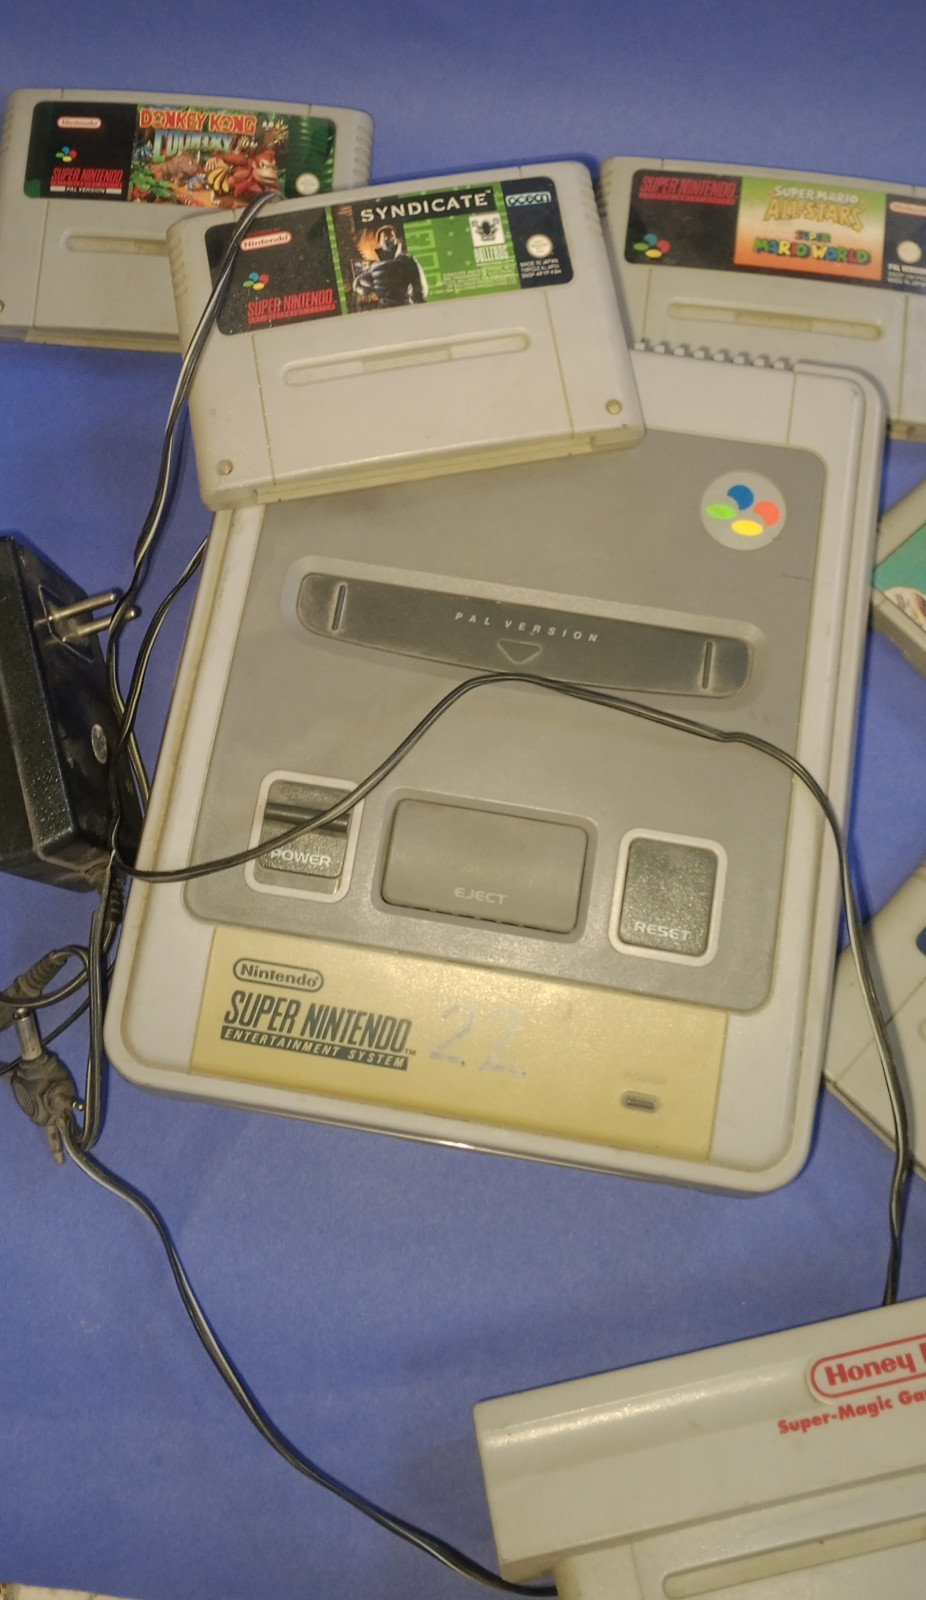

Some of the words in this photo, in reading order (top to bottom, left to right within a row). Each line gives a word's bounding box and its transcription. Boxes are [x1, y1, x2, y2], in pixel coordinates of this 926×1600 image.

[140, 108, 208, 131] DONKEY
[208, 112, 257, 136] KONG
[153, 129, 235, 163] COUNTRY
[52, 167, 81, 181] SUPER
[80, 168, 124, 184] NINTENDO
[641, 175, 678, 194] SUPER
[679, 178, 738, 198] NINTENDO
[360, 194, 488, 222] SYNDICATE
[775, 186, 815, 200] SUPER
[816, 190, 859, 205] MARIO
[795, 230, 831, 243] SUPER
[754, 236, 811, 259] MARIO
[811, 243, 873, 266] WORLD
[248, 297, 281, 318] SUPER
[283, 288, 334, 312] NINTENDO
[455, 612, 490, 626] PAL
[505, 620, 598, 642] VERSION
[270, 848, 332, 868] POWER
[454, 886, 508, 905] EJECT
[634, 921, 692, 941] RESET
[240, 963, 319, 989] Nintendo
[223, 990, 301, 1034] SUPER
[300, 1003, 412, 1053] NINTENDO
[224, 1028, 341, 1058] ENTERTAINMENT
[347, 1050, 406, 1069] SYSTEM
[825, 1353, 916, 1386] Honey
[777, 1395, 893, 1434] Super-Magic
[898, 1390, 926, 1406] Ga
